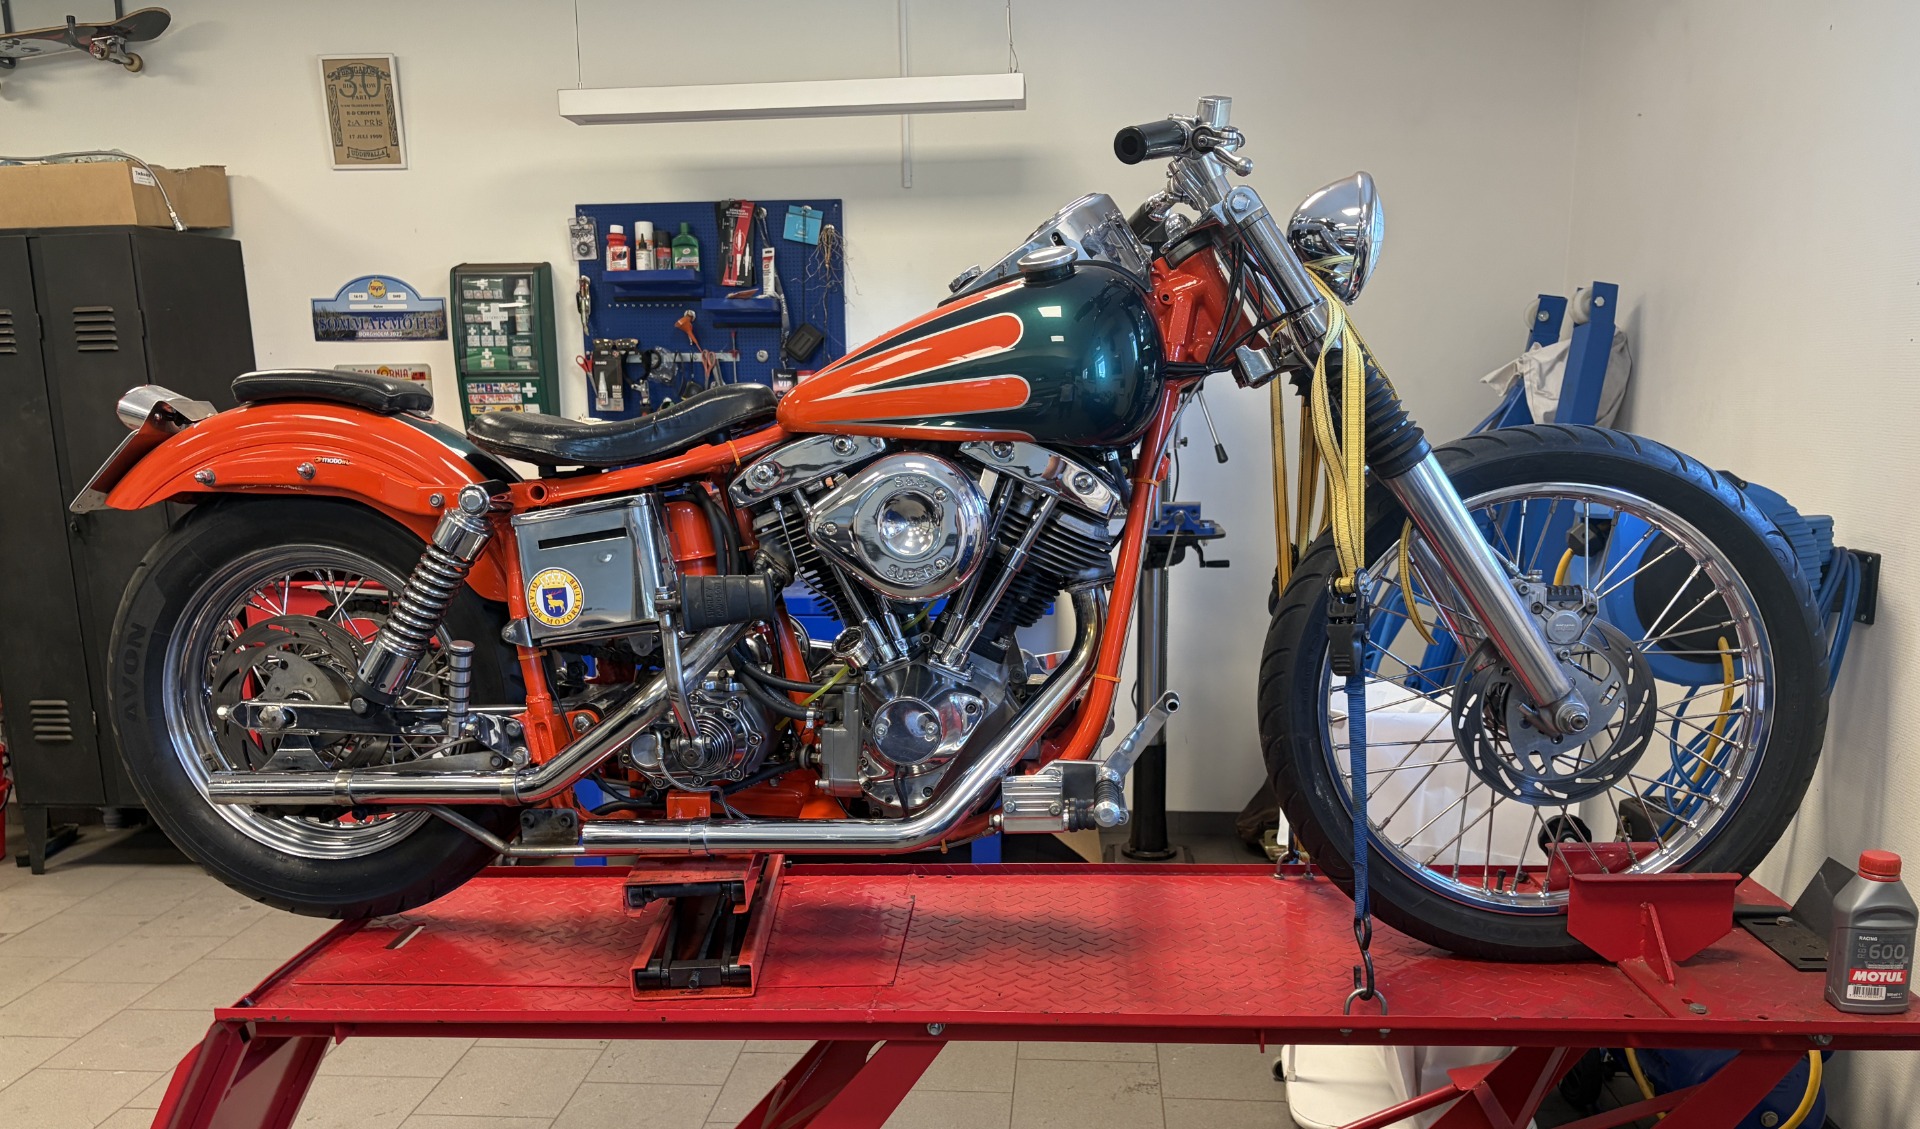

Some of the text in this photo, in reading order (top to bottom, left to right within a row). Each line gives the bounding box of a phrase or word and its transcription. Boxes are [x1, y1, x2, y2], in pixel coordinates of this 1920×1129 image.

[318, 313, 442, 331] SOMMARMÖTET
[778, 380, 793, 388] VIP
[885, 562, 935, 582] SUPER
[121, 622, 147, 722] AVON
[1869, 944, 1906, 960] 600
[1852, 970, 1904, 983] MOTUL
